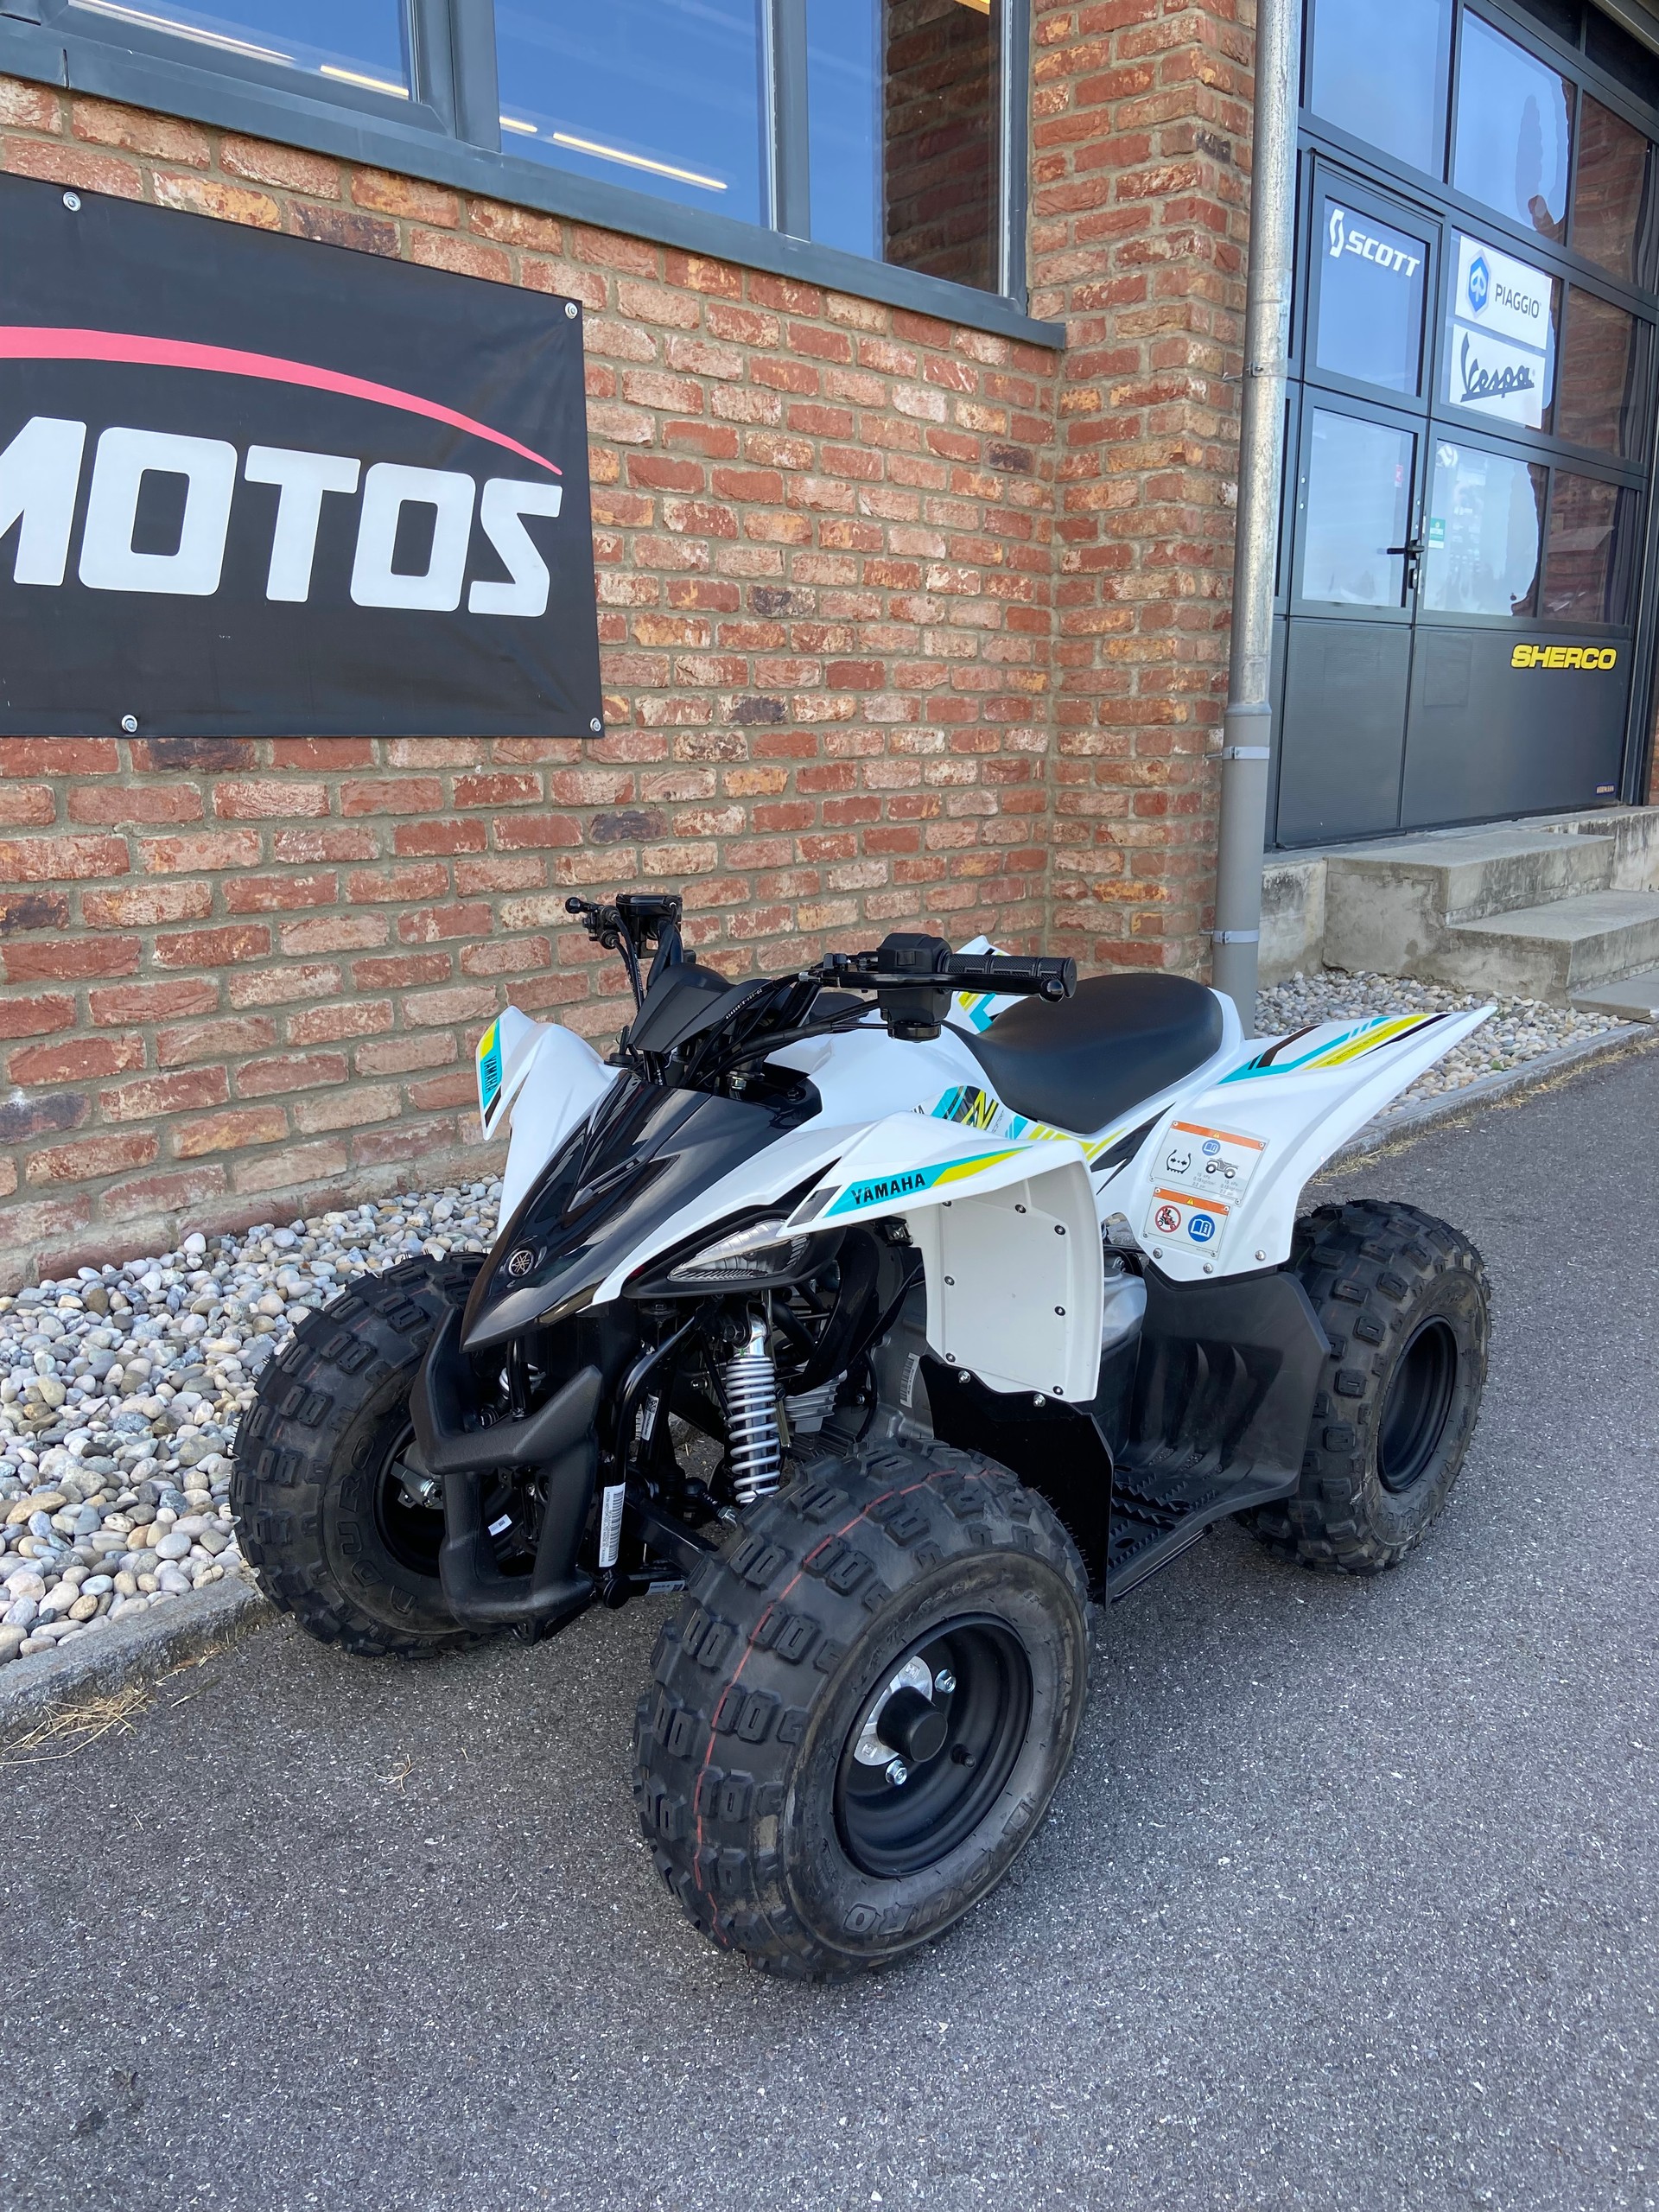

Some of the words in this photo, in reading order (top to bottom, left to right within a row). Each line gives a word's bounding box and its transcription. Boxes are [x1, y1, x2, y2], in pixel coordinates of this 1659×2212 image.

[1345, 230, 1421, 277] SCOTT
[1495, 283, 1540, 319] PIAGGIO
[1460, 331, 1535, 403] Vespa
[1510, 644, 1618, 671] SHERCO
[483, 1055, 498, 1094] YAMAHA
[851, 1173, 926, 1205] YAMAHA
